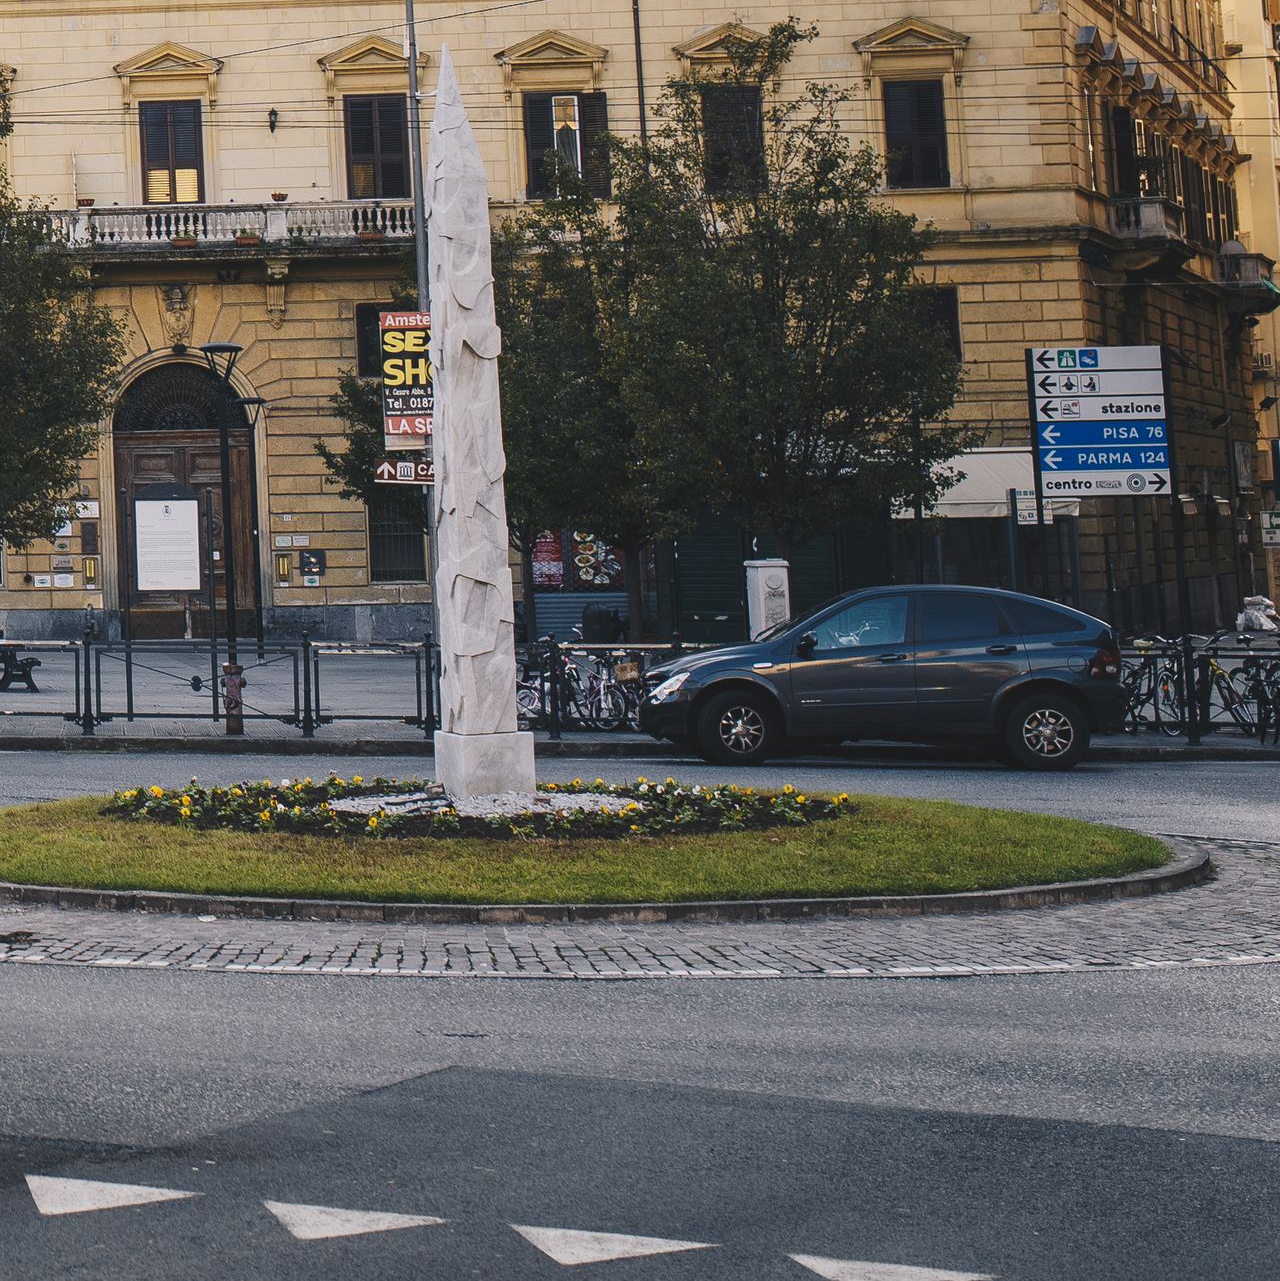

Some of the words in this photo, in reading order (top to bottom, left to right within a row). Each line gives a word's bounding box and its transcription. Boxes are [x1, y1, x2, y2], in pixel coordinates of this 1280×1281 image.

[385, 314, 431, 327] Amste
[383, 330, 431, 353] SE
[383, 359, 433, 386] SH
[387, 398, 406, 409] Tel.
[1101, 402, 1162, 414] stazione
[388, 418, 412, 434] LA
[1103, 427, 1140, 439] PISA
[1145, 426, 1164, 438] 76
[1078, 452, 1133, 465] PARMA
[1139, 451, 1166, 464] 124
[1045, 478, 1093, 490] centro
